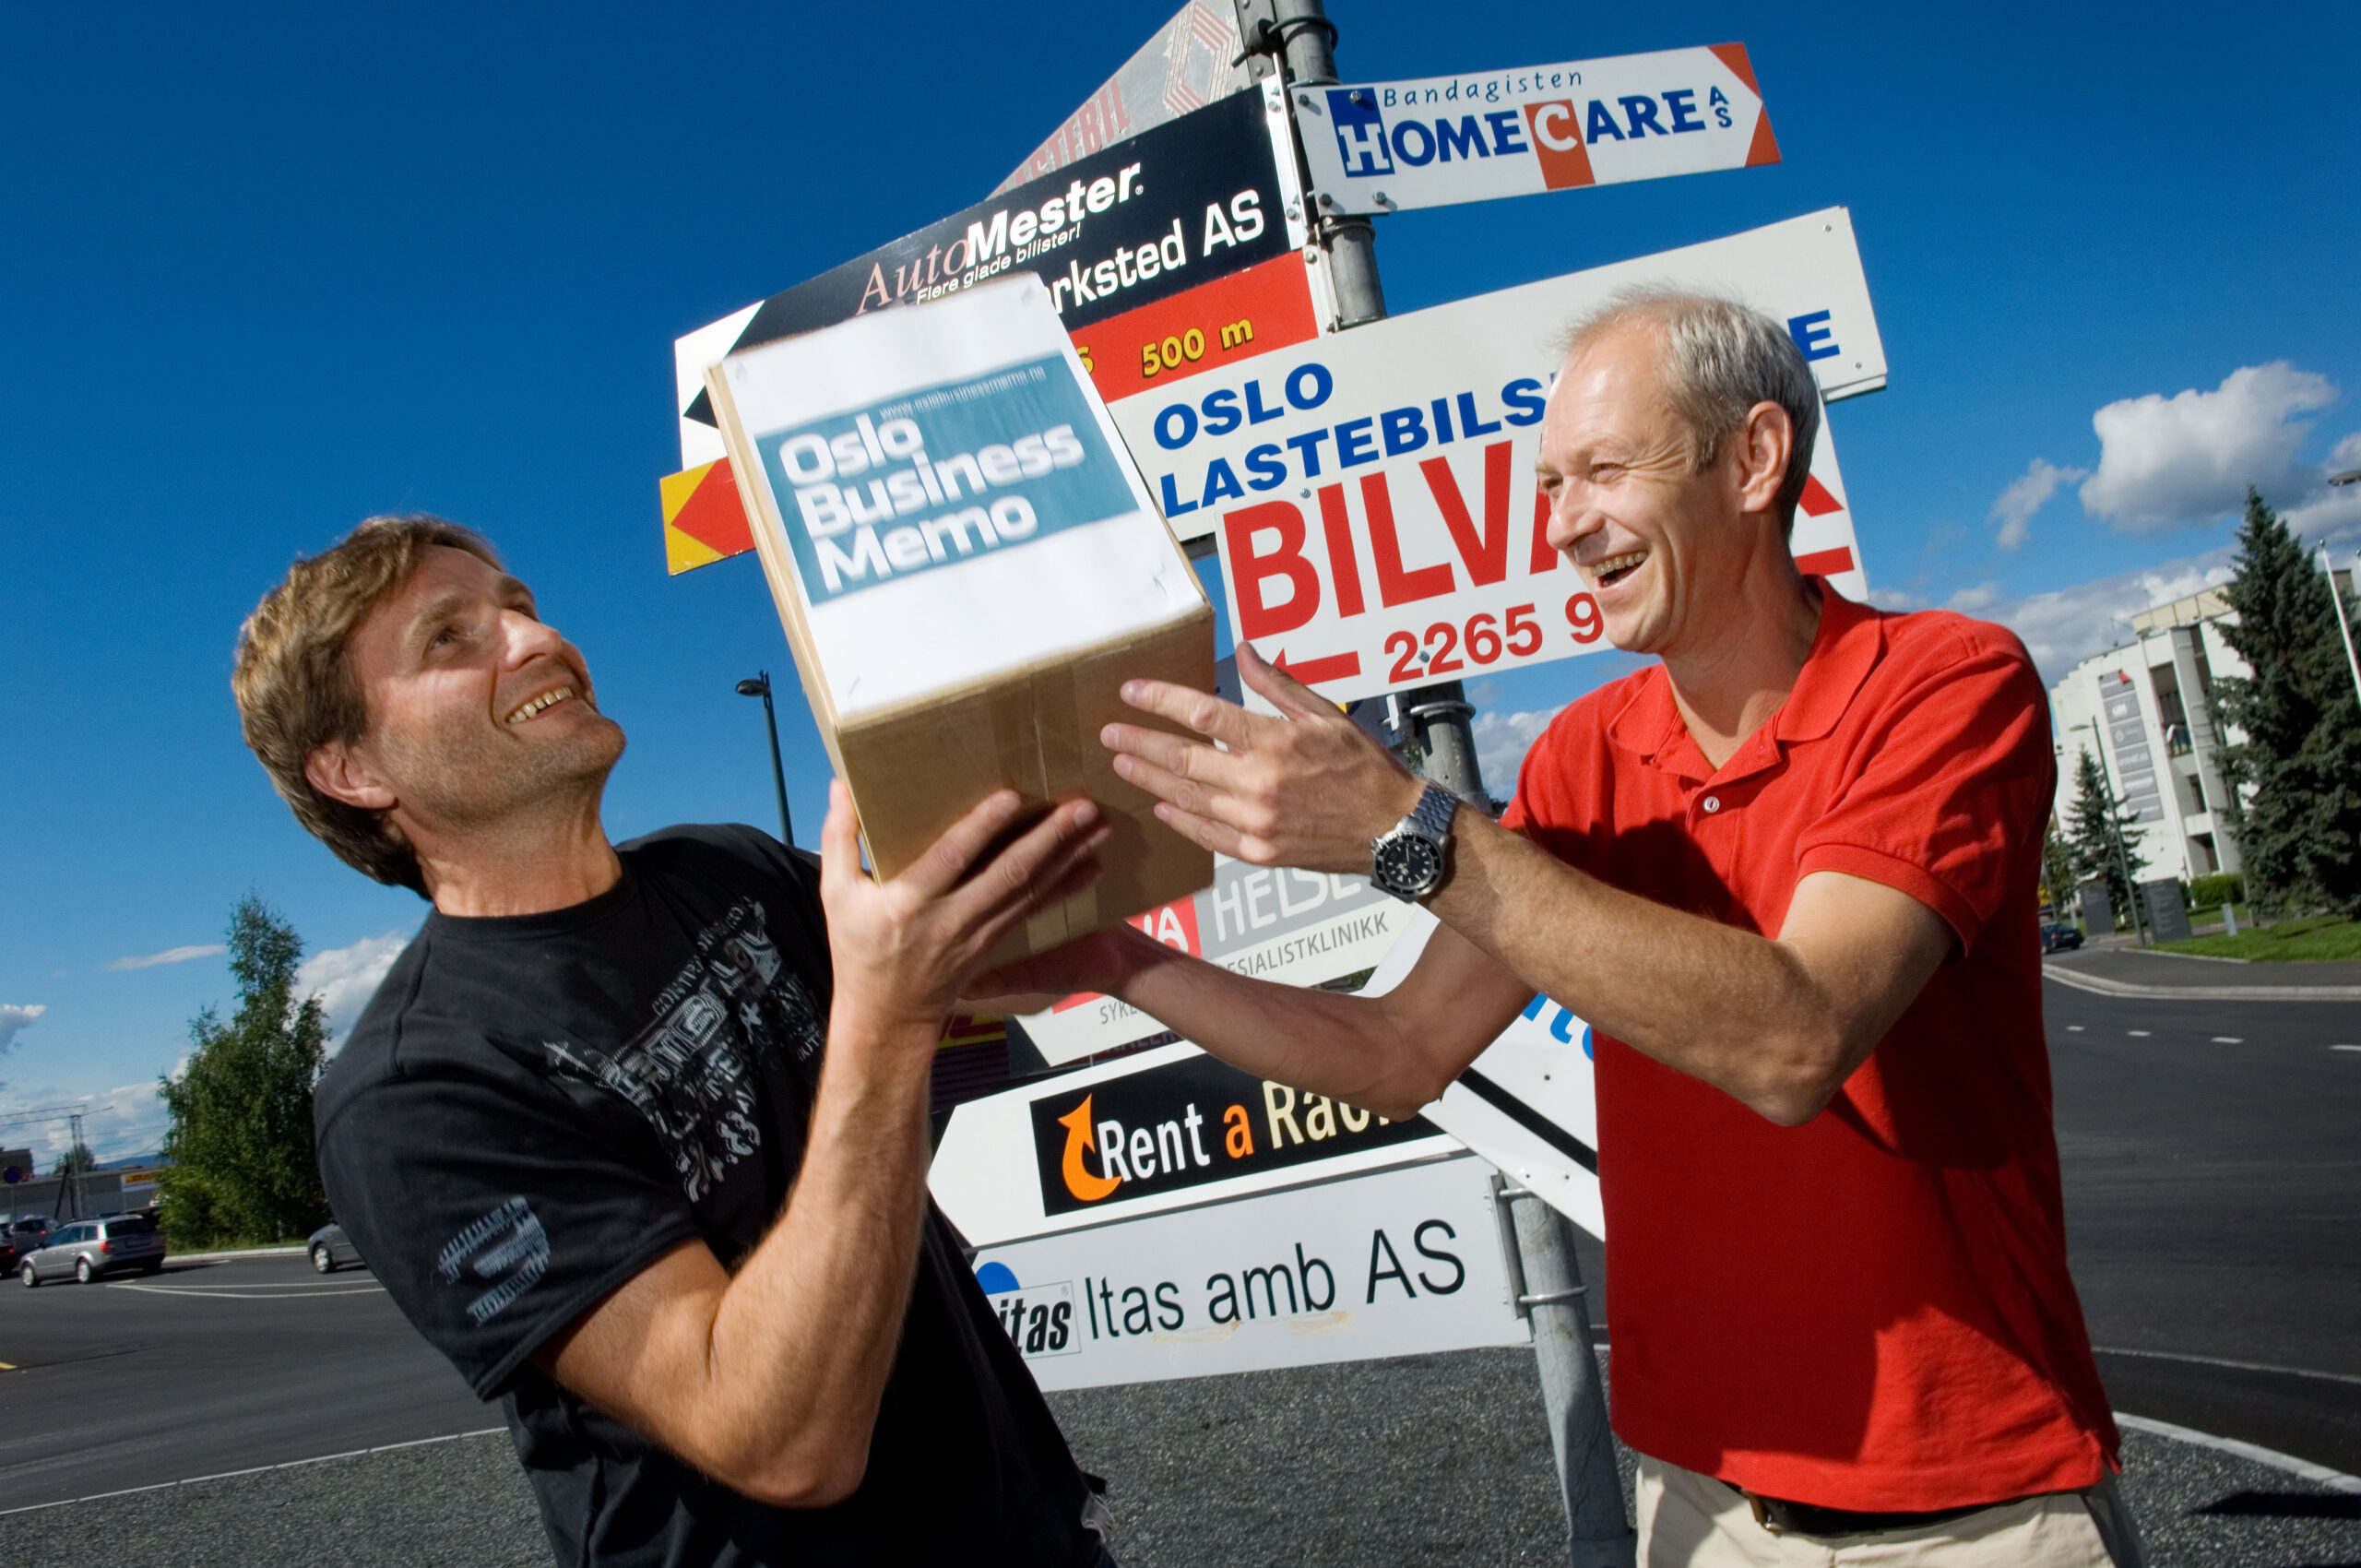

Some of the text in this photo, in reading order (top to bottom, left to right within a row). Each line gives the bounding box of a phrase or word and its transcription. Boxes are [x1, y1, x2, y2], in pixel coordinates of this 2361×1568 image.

[1337, 89, 1707, 173] HOMECARE
[1383, 71, 1583, 107] Bandagisten
[916, 221, 1081, 305] Flere glade bilister!
[1045, 188, 1264, 315] rksted AS
[1141, 327, 1205, 379] 500
[1220, 318, 1254, 350] m
[1153, 362, 1334, 450] OSLO
[778, 413, 924, 486] Oslo
[793, 423, 1086, 539] Business
[812, 494, 1039, 592] Memo
[1383, 602, 1543, 684] 2265
[1097, 1102, 1211, 1182] Rent
[1223, 1104, 1254, 1159] a
[1206, 1241, 1336, 1324] amb
[1366, 1218, 1466, 1305] AS
